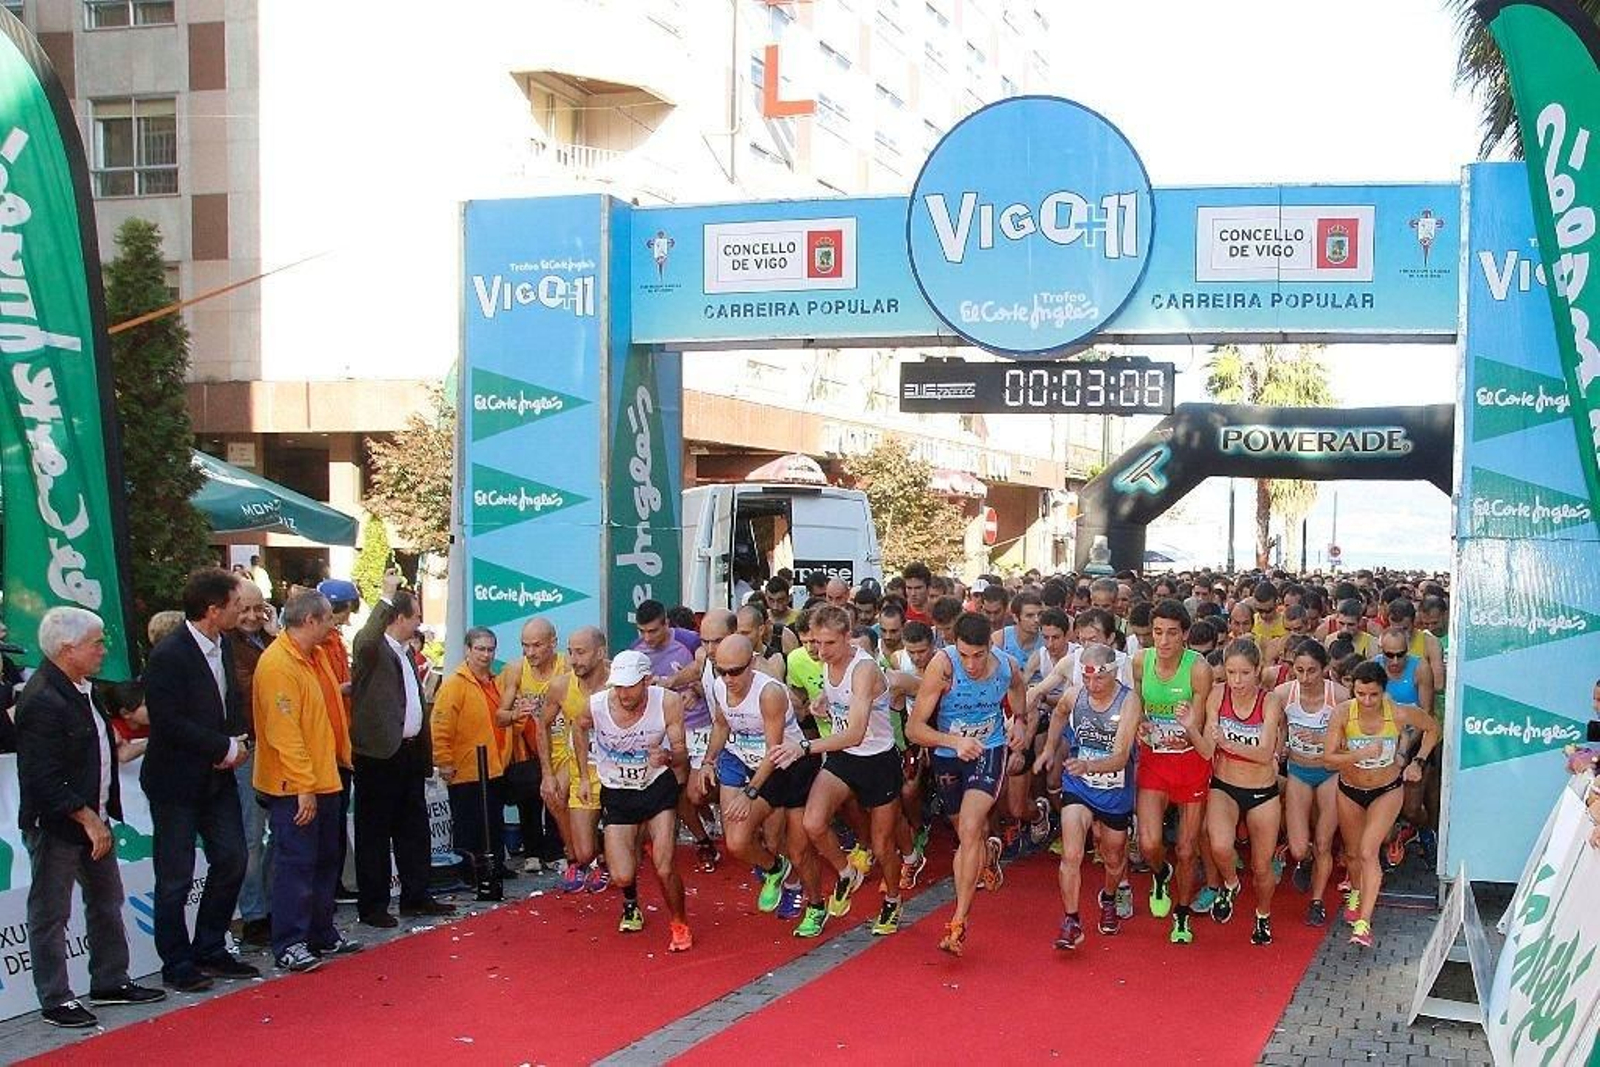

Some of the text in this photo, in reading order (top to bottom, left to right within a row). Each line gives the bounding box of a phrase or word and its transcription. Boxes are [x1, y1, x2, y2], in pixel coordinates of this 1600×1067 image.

[1219, 228, 1304, 242] CONCELLO
[723, 241, 796, 257] CONCELLO
[1229, 245, 1294, 258] DE VIGO
[731, 258, 788, 271] DE VIGO
[1041, 292, 1086, 303] Trofeo
[1151, 292, 1375, 309] CARREIRA POPULAR
[704, 299, 900, 319] CARREIRA POPULAR
[981, 300, 1028, 322] Corte
[1004, 369, 1165, 407] 00:03:08
[487, 394, 518, 411] Corte
[1494, 388, 1535, 407] Corte
[1223, 429, 1402, 452] POWERADE
[487, 490, 518, 506] Corte
[1491, 499, 1530, 518] Corte
[487, 585, 518, 602] Corte
[1482, 717, 1521, 737] Corte
[618, 765, 649, 780] 187
